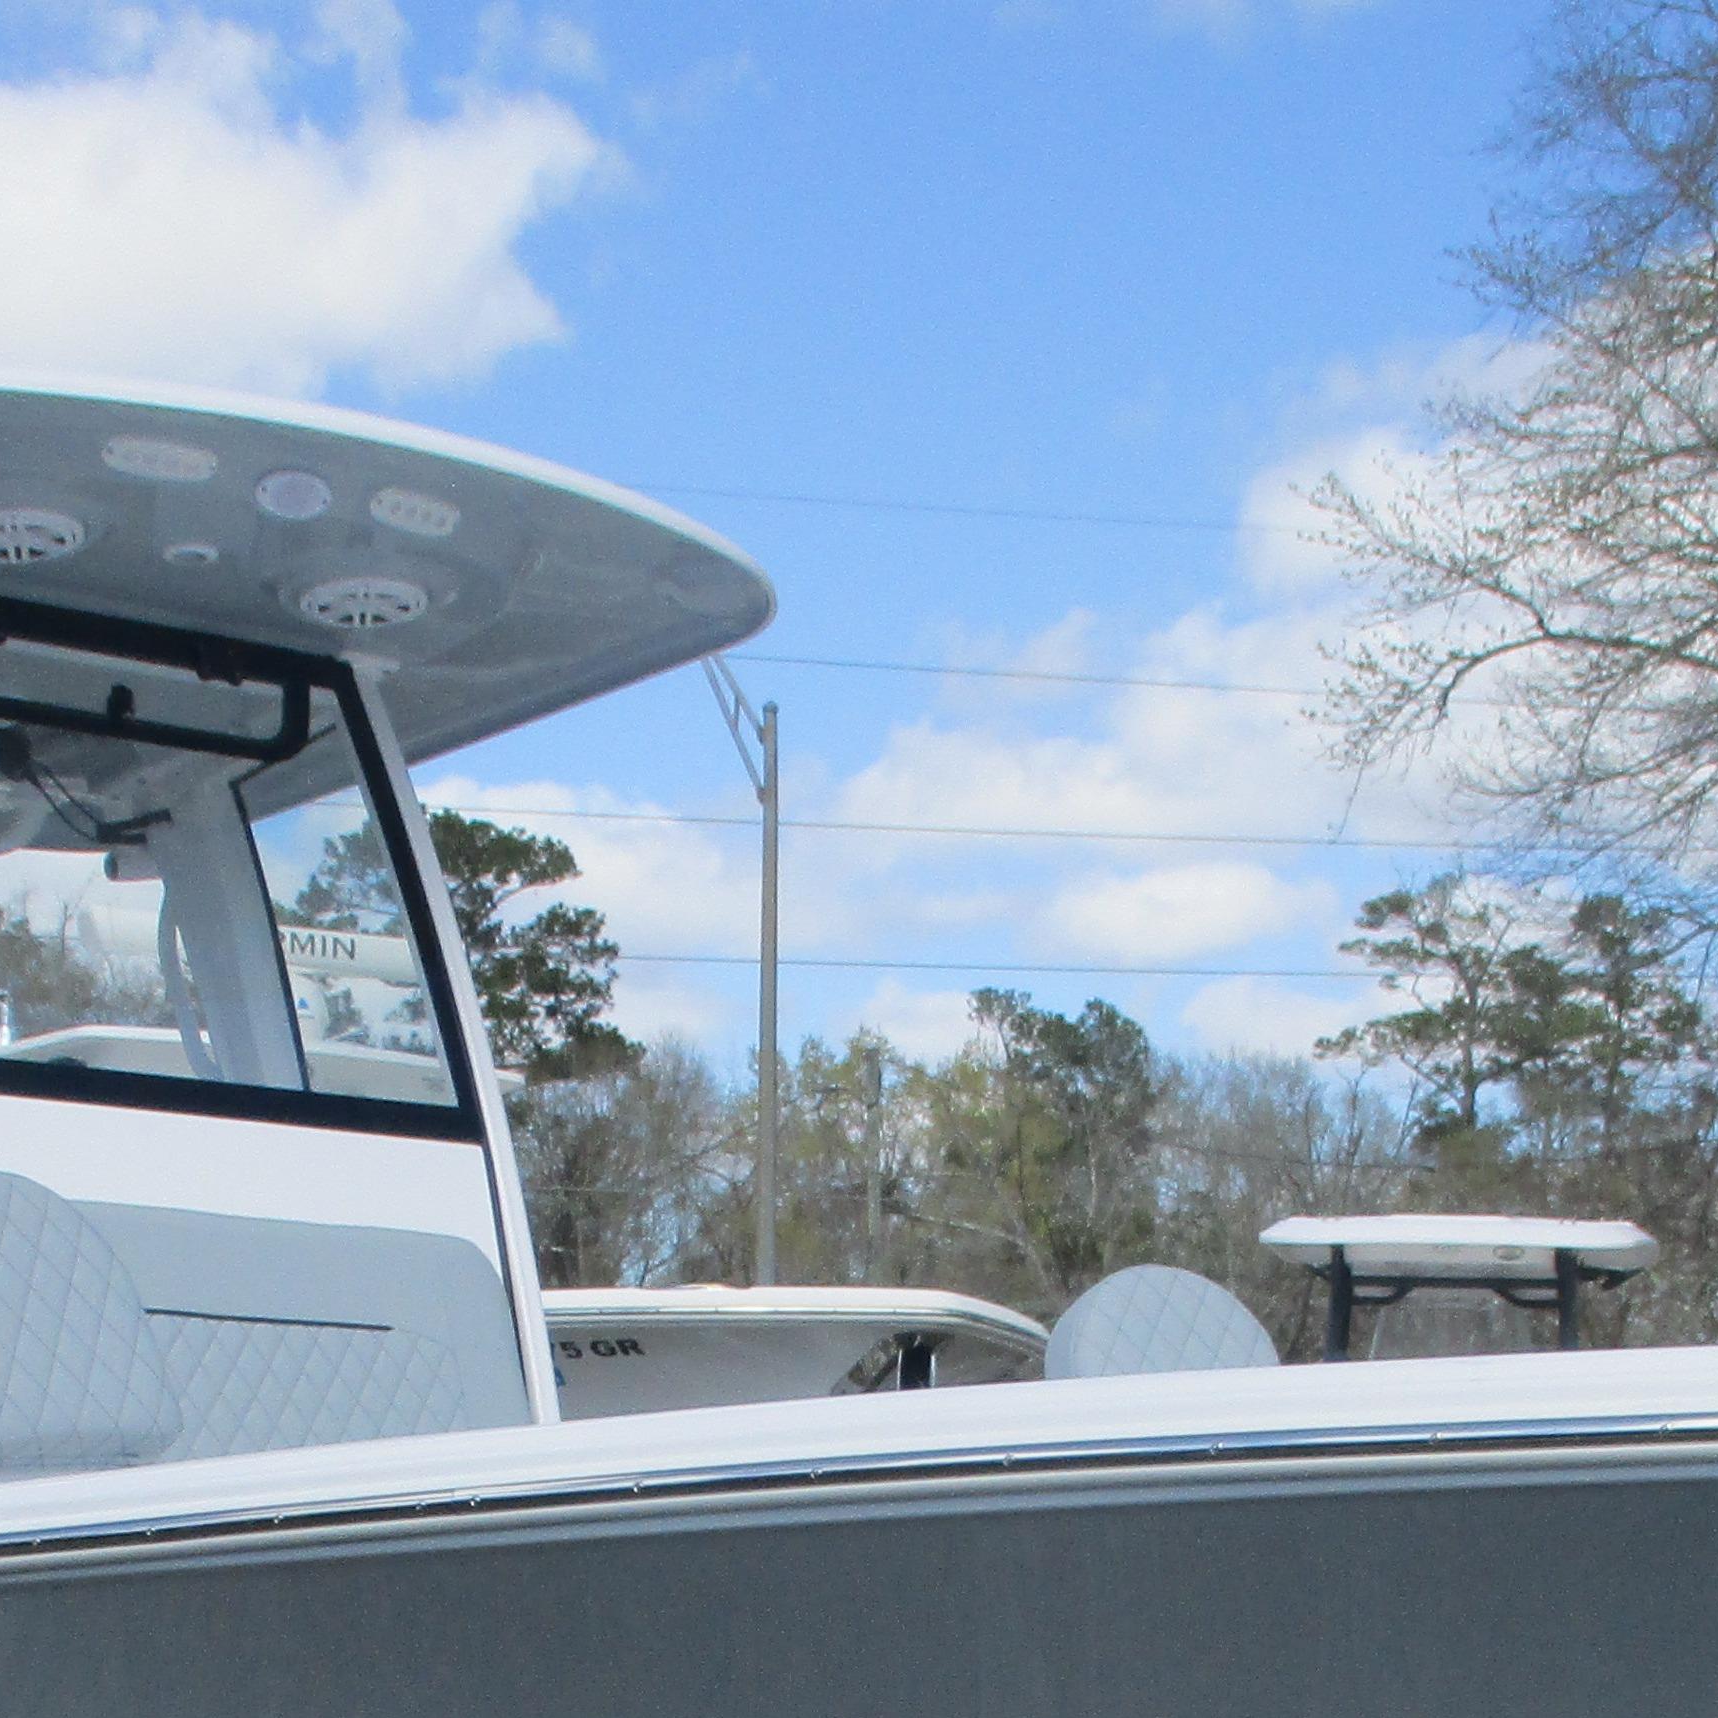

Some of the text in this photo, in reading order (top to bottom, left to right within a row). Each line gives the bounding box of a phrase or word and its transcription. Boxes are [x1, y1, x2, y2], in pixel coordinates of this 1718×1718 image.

[279, 931, 356, 961] MIN
[552, 1338, 645, 1360] 5 GR
